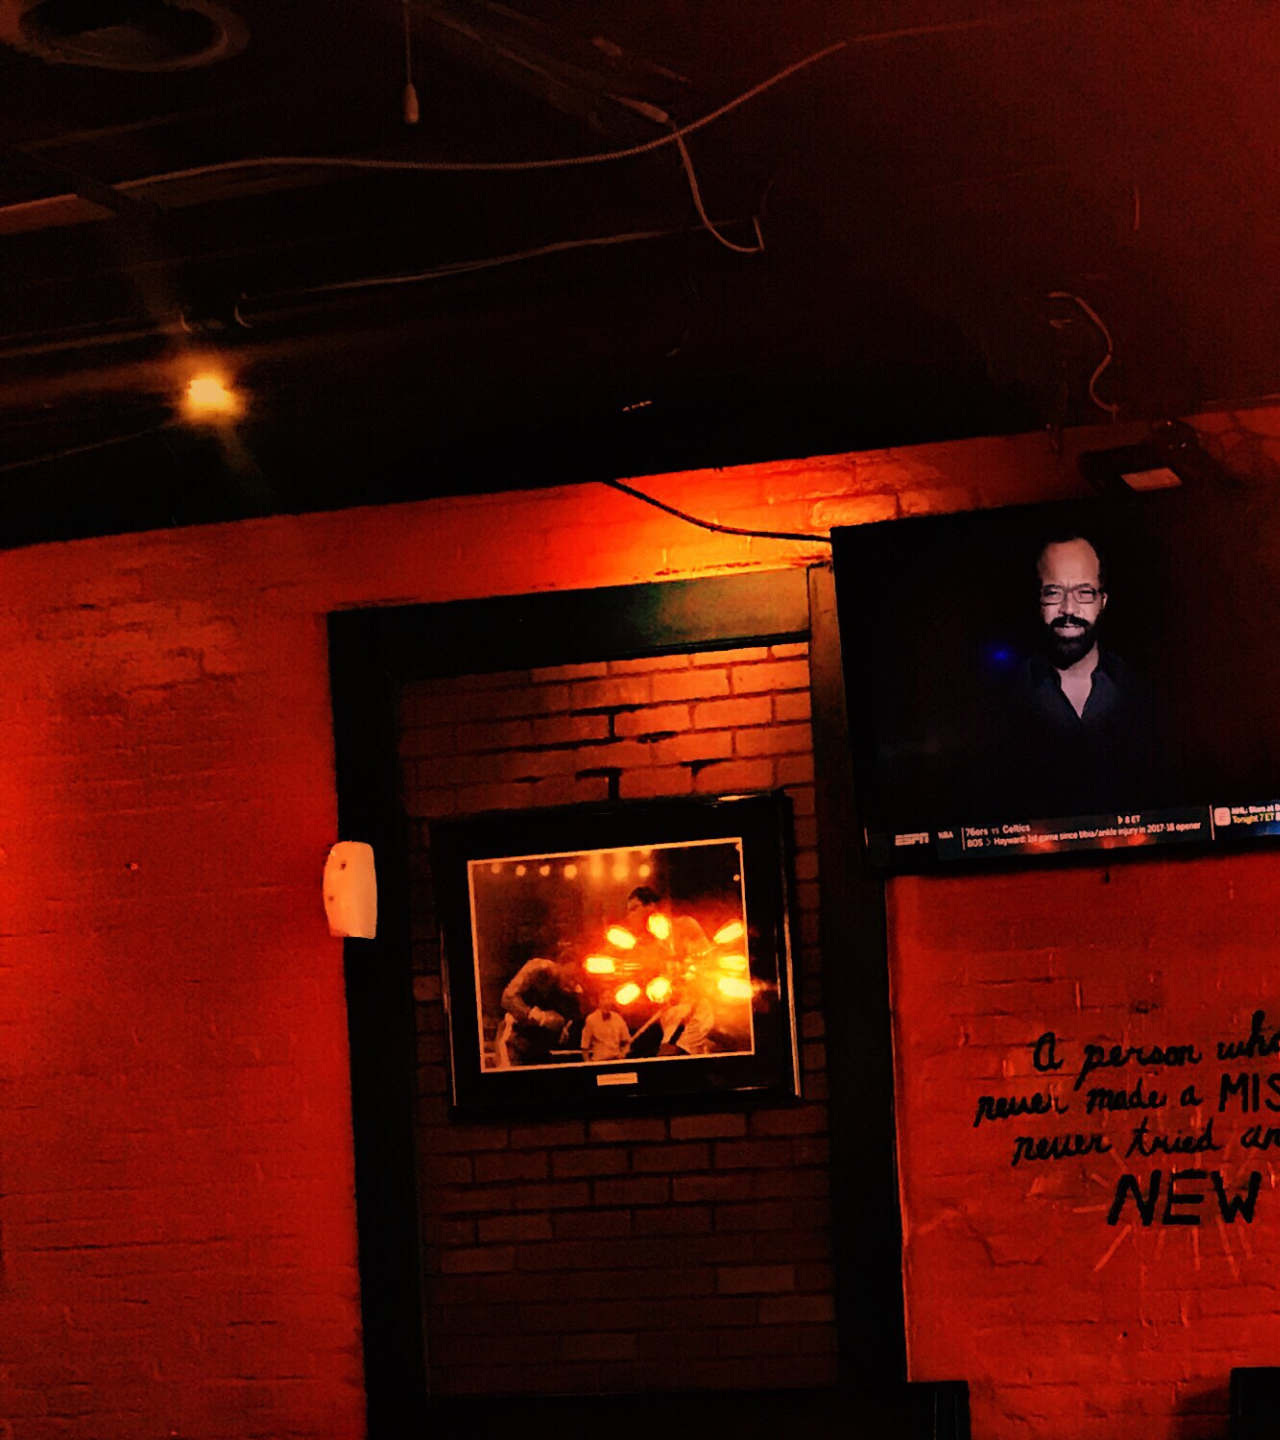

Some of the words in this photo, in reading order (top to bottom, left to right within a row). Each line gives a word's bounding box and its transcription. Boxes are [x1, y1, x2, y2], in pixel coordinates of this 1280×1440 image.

[895, 832, 930, 847] ESPN
[1002, 824, 1031, 834] Celtics
[1074, 1041, 1201, 1091] person
[973, 1091, 1068, 1128] never
[1086, 1080, 1167, 1115] made
[1180, 1083, 1202, 1107] a
[1011, 1132, 1112, 1166] never
[1125, 1118, 1222, 1158] tried
[1107, 1168, 1262, 1227] NEW
